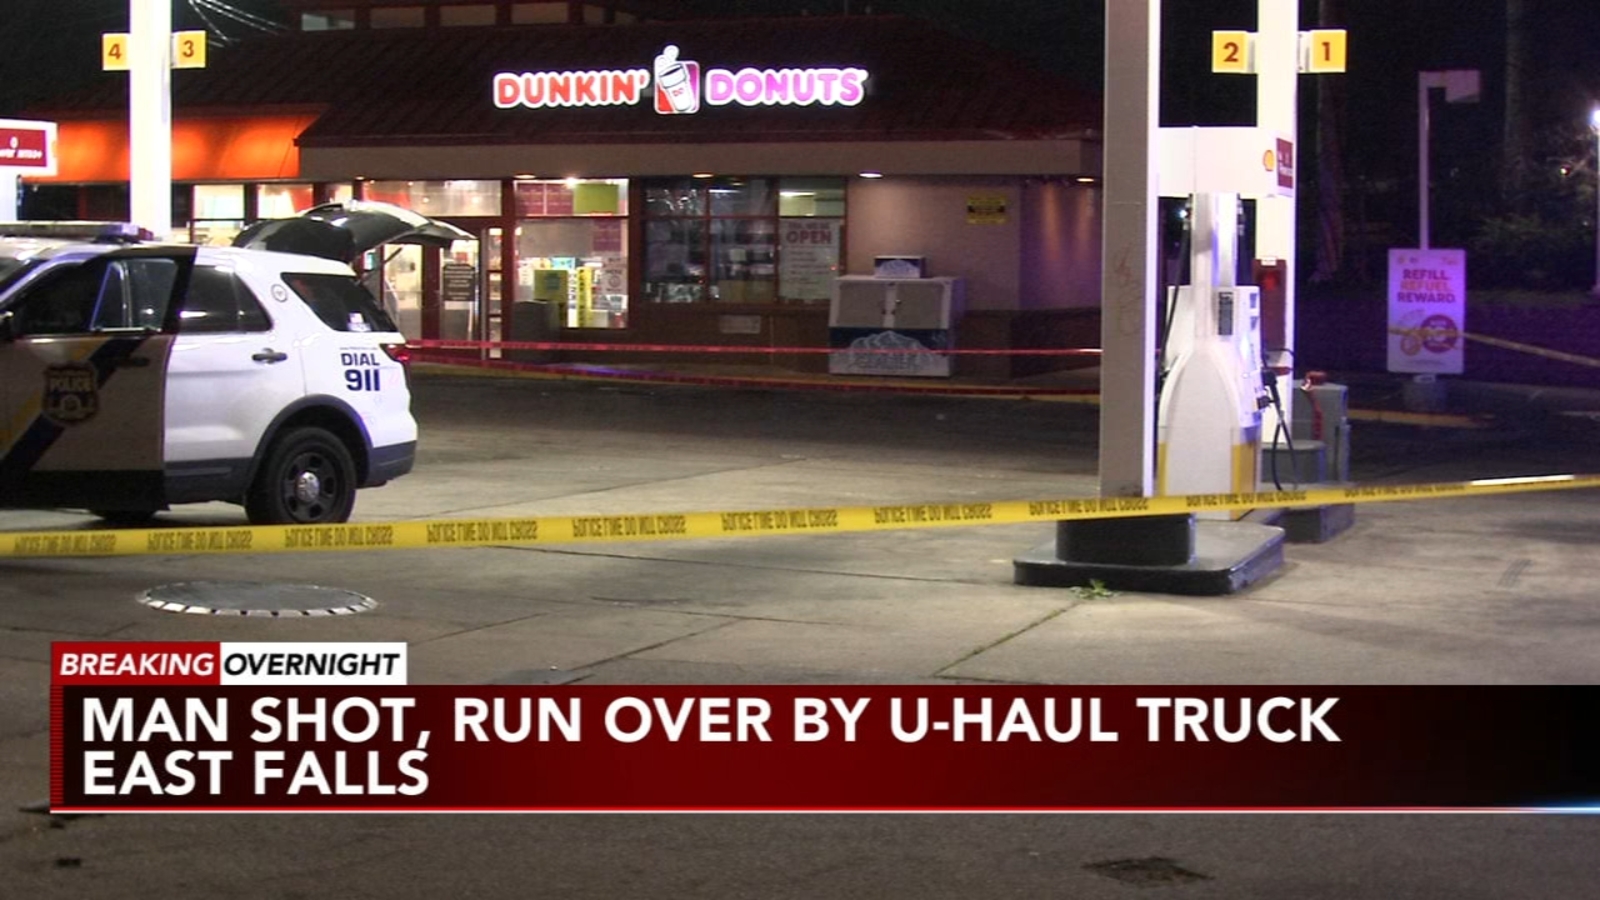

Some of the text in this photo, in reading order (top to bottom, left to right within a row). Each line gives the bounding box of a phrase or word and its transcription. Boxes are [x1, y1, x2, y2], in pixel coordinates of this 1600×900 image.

[108, 43, 122, 60] 4
[182, 39, 195, 58] 3
[1223, 41, 1239, 62] 2
[1322, 41, 1331, 61] 1
[497, 72, 861, 105] DUNKIN' DONUTS
[786, 230, 832, 244] OPEN
[341, 353, 380, 366] DIAL
[345, 369, 380, 391] 911
